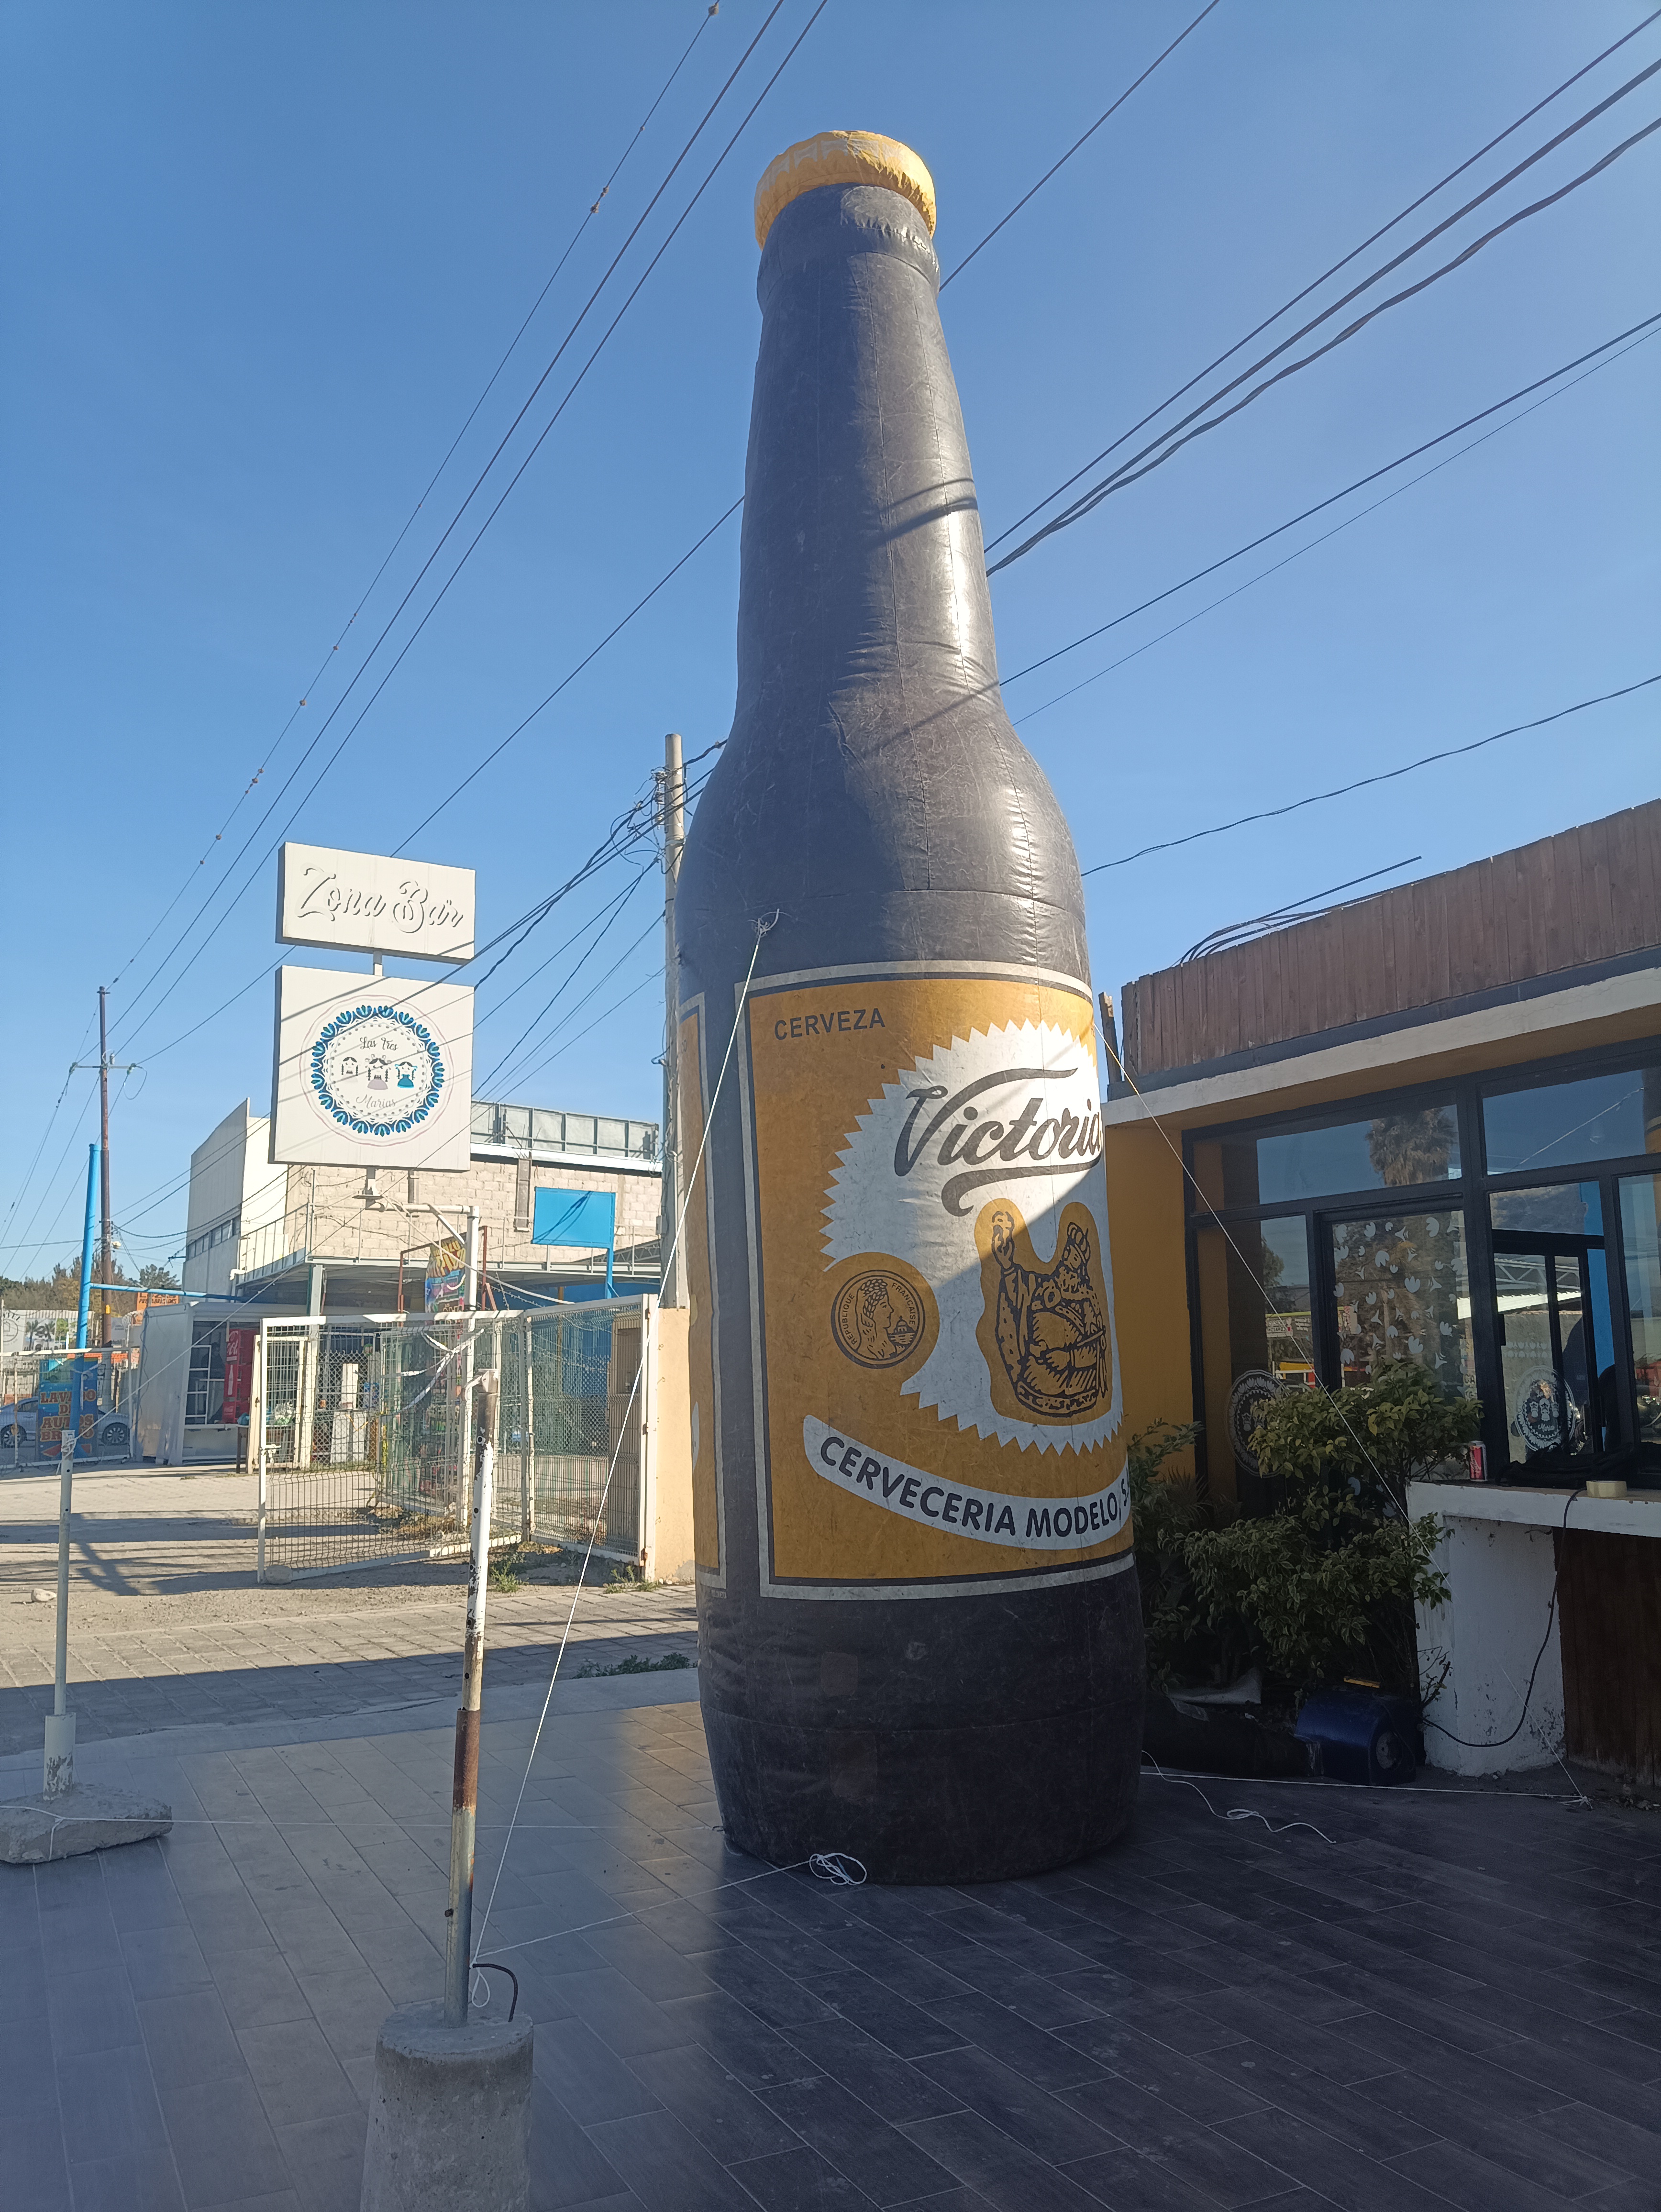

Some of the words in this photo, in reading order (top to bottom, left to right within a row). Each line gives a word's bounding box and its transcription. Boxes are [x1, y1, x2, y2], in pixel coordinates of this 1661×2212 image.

[294, 863, 386, 922] Zona
[390, 879, 464, 933] Bar
[775, 1008, 886, 1040] CERVEZA
[360, 1036, 377, 1050] Las
[381, 1037, 399, 1051] Tres
[355, 1094, 396, 1109] Marias
[842, 1293, 858, 1345] REPUBLIQUE
[40, 1389, 96, 1404] LAVO
[820, 1437, 1016, 1536] CERVECERIA
[1026, 1492, 1121, 1537] MODELO,
